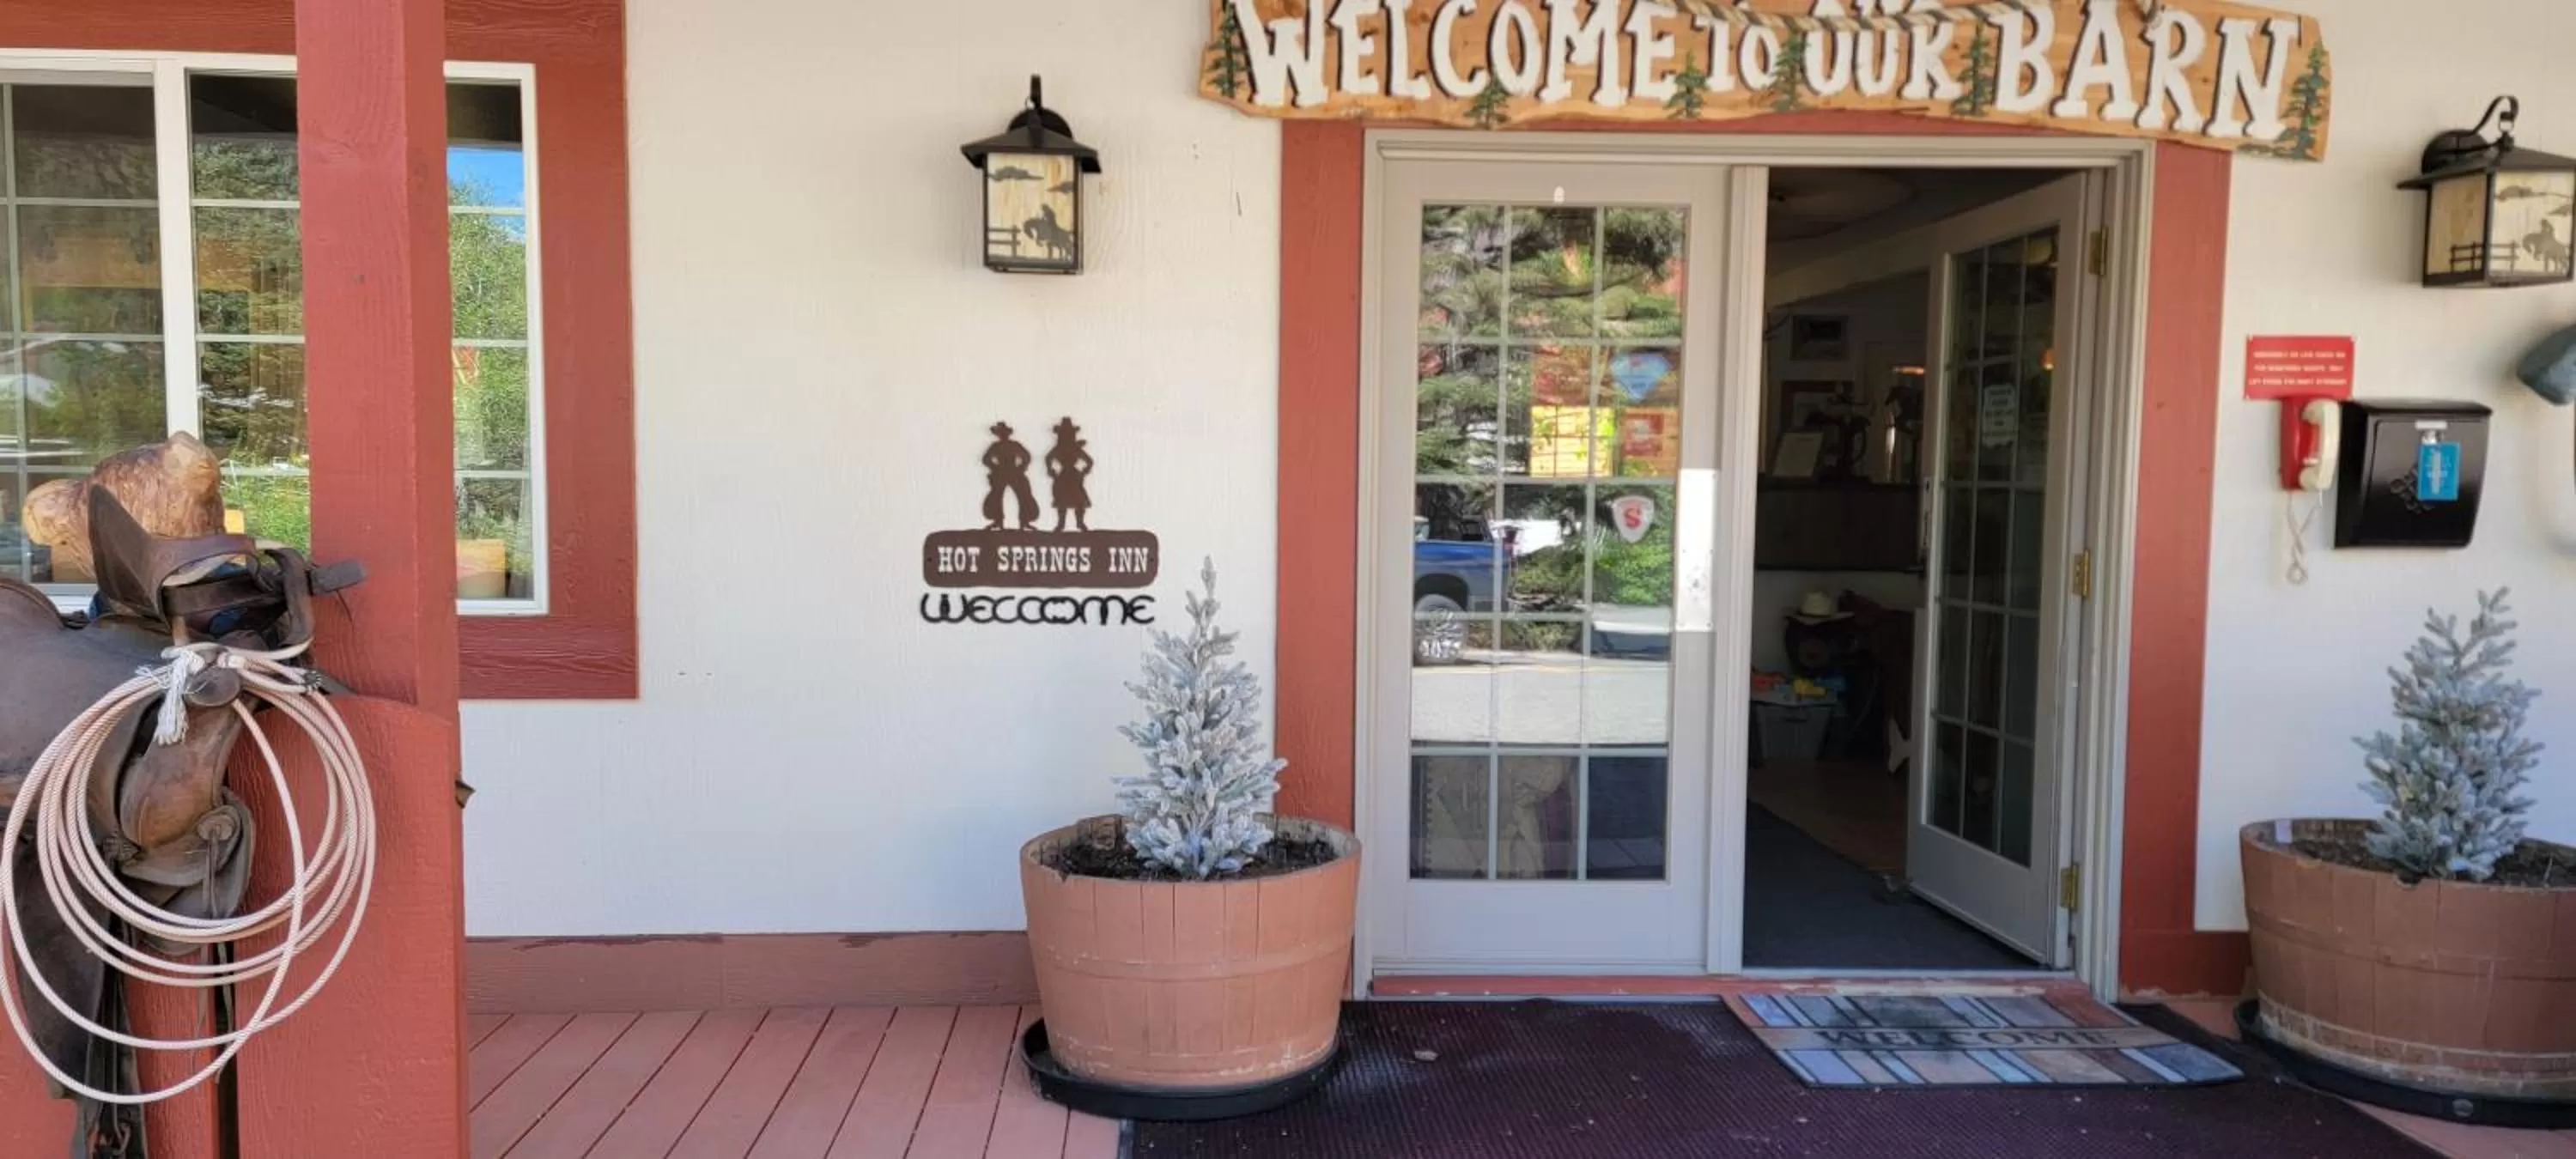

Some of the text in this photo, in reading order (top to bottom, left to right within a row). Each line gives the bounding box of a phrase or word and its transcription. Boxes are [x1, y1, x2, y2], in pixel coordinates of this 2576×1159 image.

[1233, 0, 1680, 106] WELCOME
[1989, 0, 2300, 140] BARN
[937, 546, 1150, 573] HOT SPRINGS INN
[1814, 1031, 2117, 1049] WELCOME
